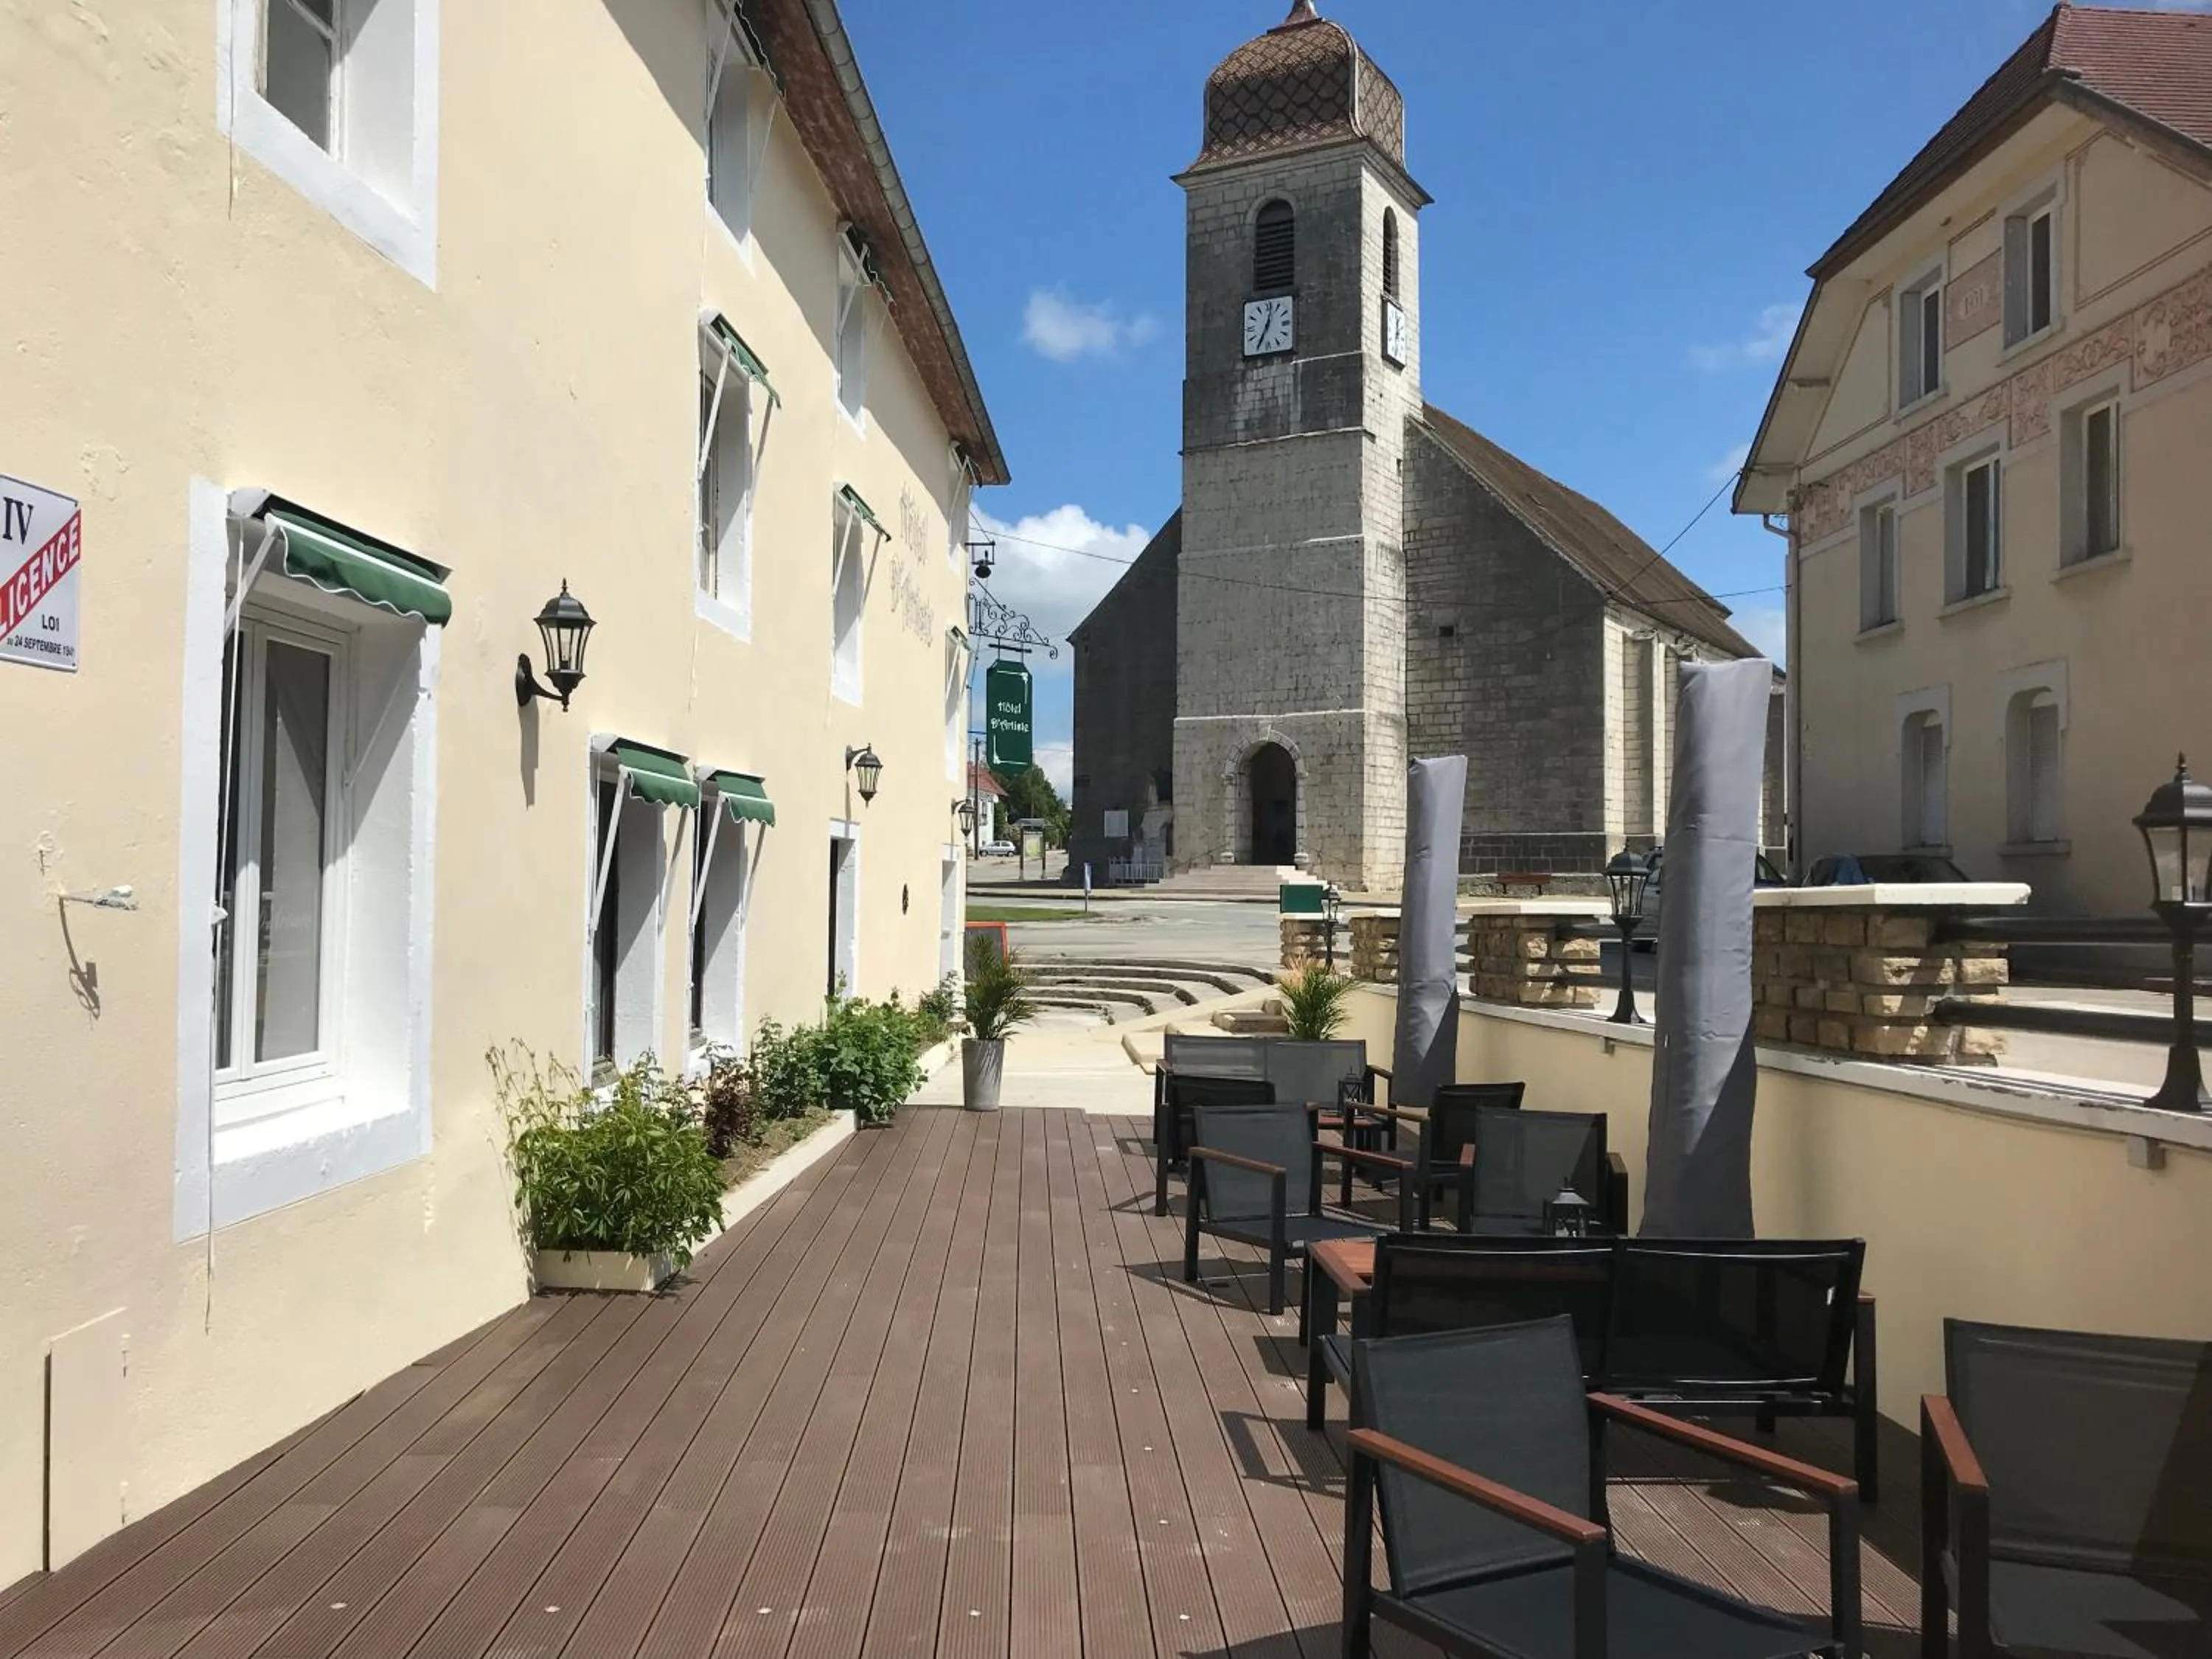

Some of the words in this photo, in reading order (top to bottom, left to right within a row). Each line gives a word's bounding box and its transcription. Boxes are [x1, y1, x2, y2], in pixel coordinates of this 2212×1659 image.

[2, 496, 34, 545] IV
[0, 516, 79, 633] LICENCE
[42, 613, 60, 632] LOI
[15, 635, 23, 647] 24
[24, 636, 62, 655] SEPTEMBRE
